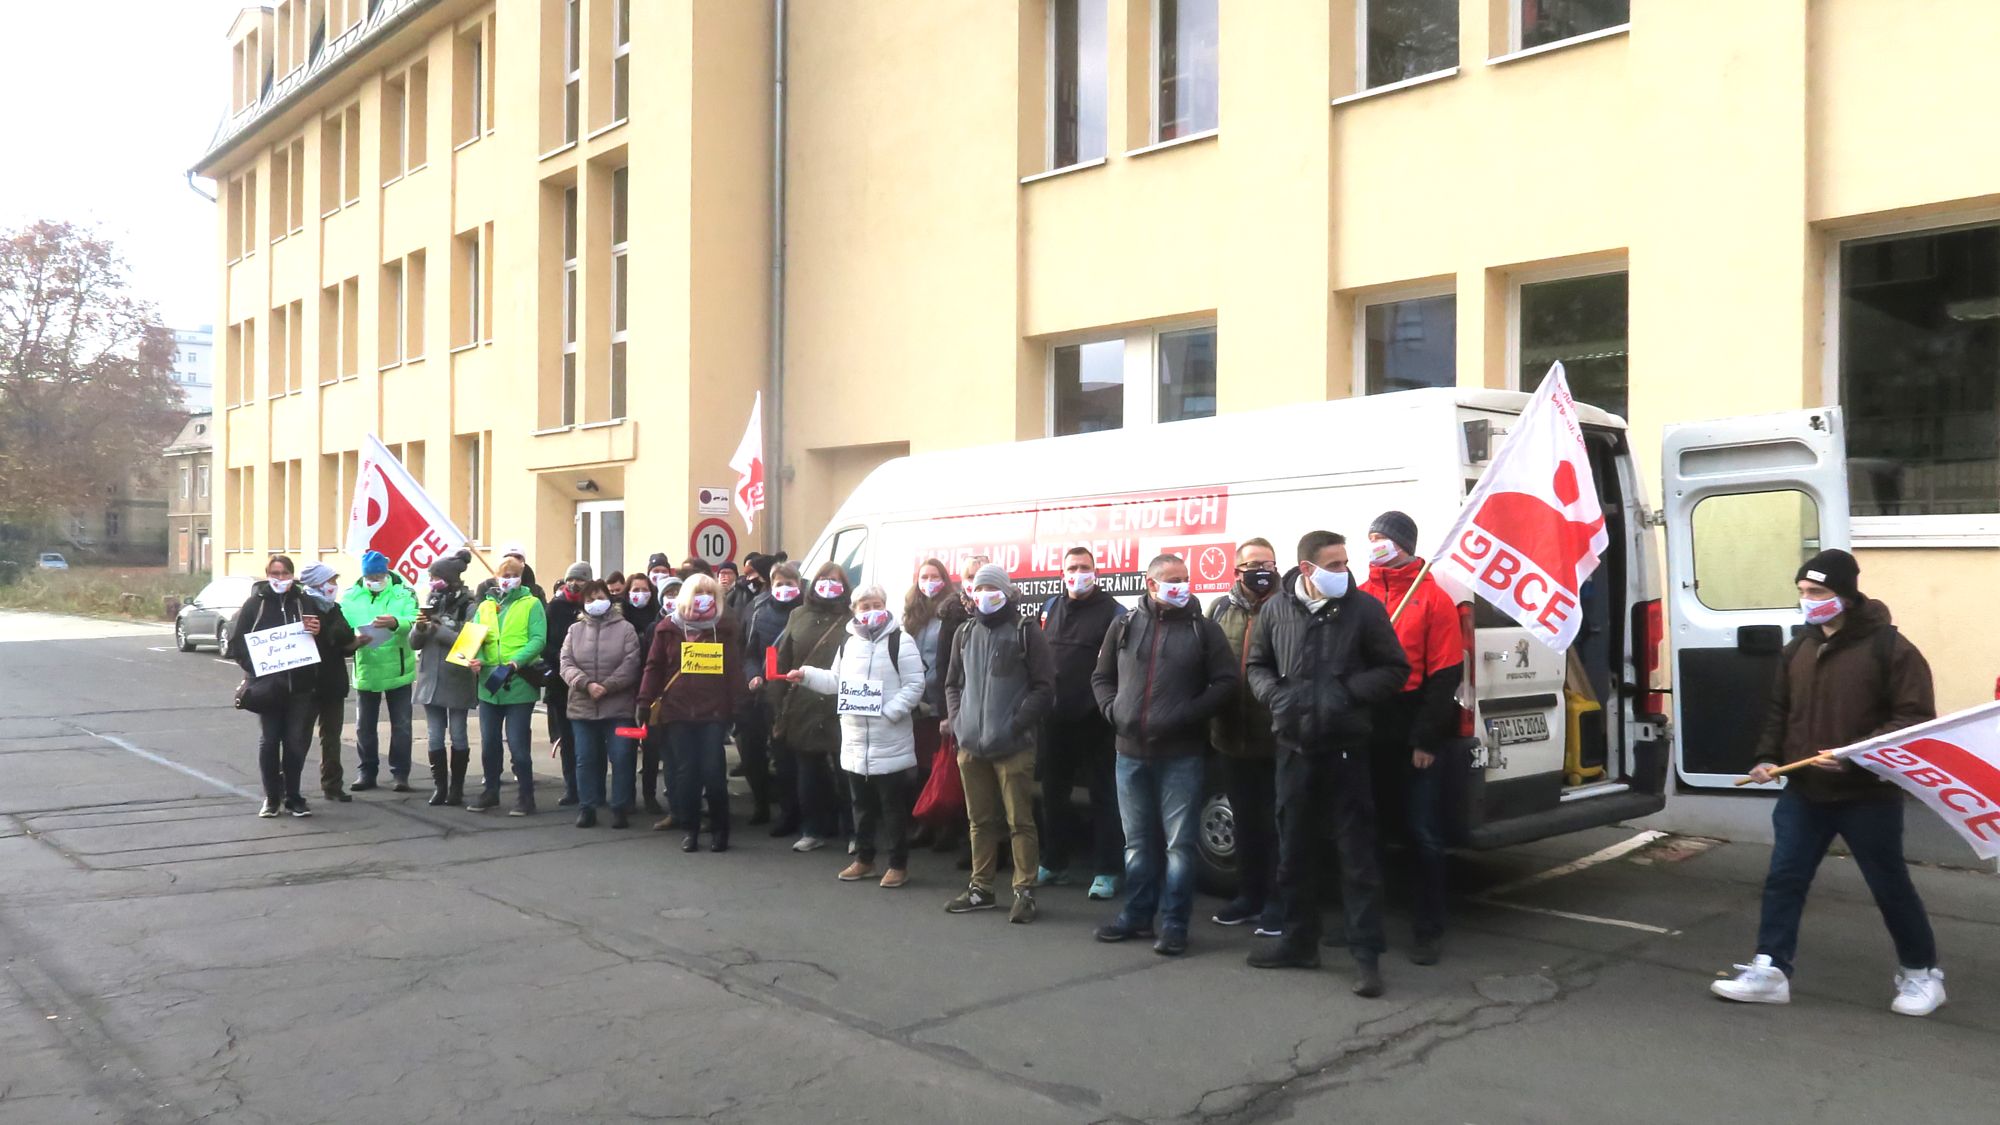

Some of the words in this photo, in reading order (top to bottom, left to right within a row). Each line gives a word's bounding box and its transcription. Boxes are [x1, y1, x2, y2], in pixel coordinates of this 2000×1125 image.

[1109, 494, 1219, 532] ENDLICH
[398, 529, 449, 586] BCE
[703, 533, 724, 557] 10
[1524, 716, 1547, 735] 2016
